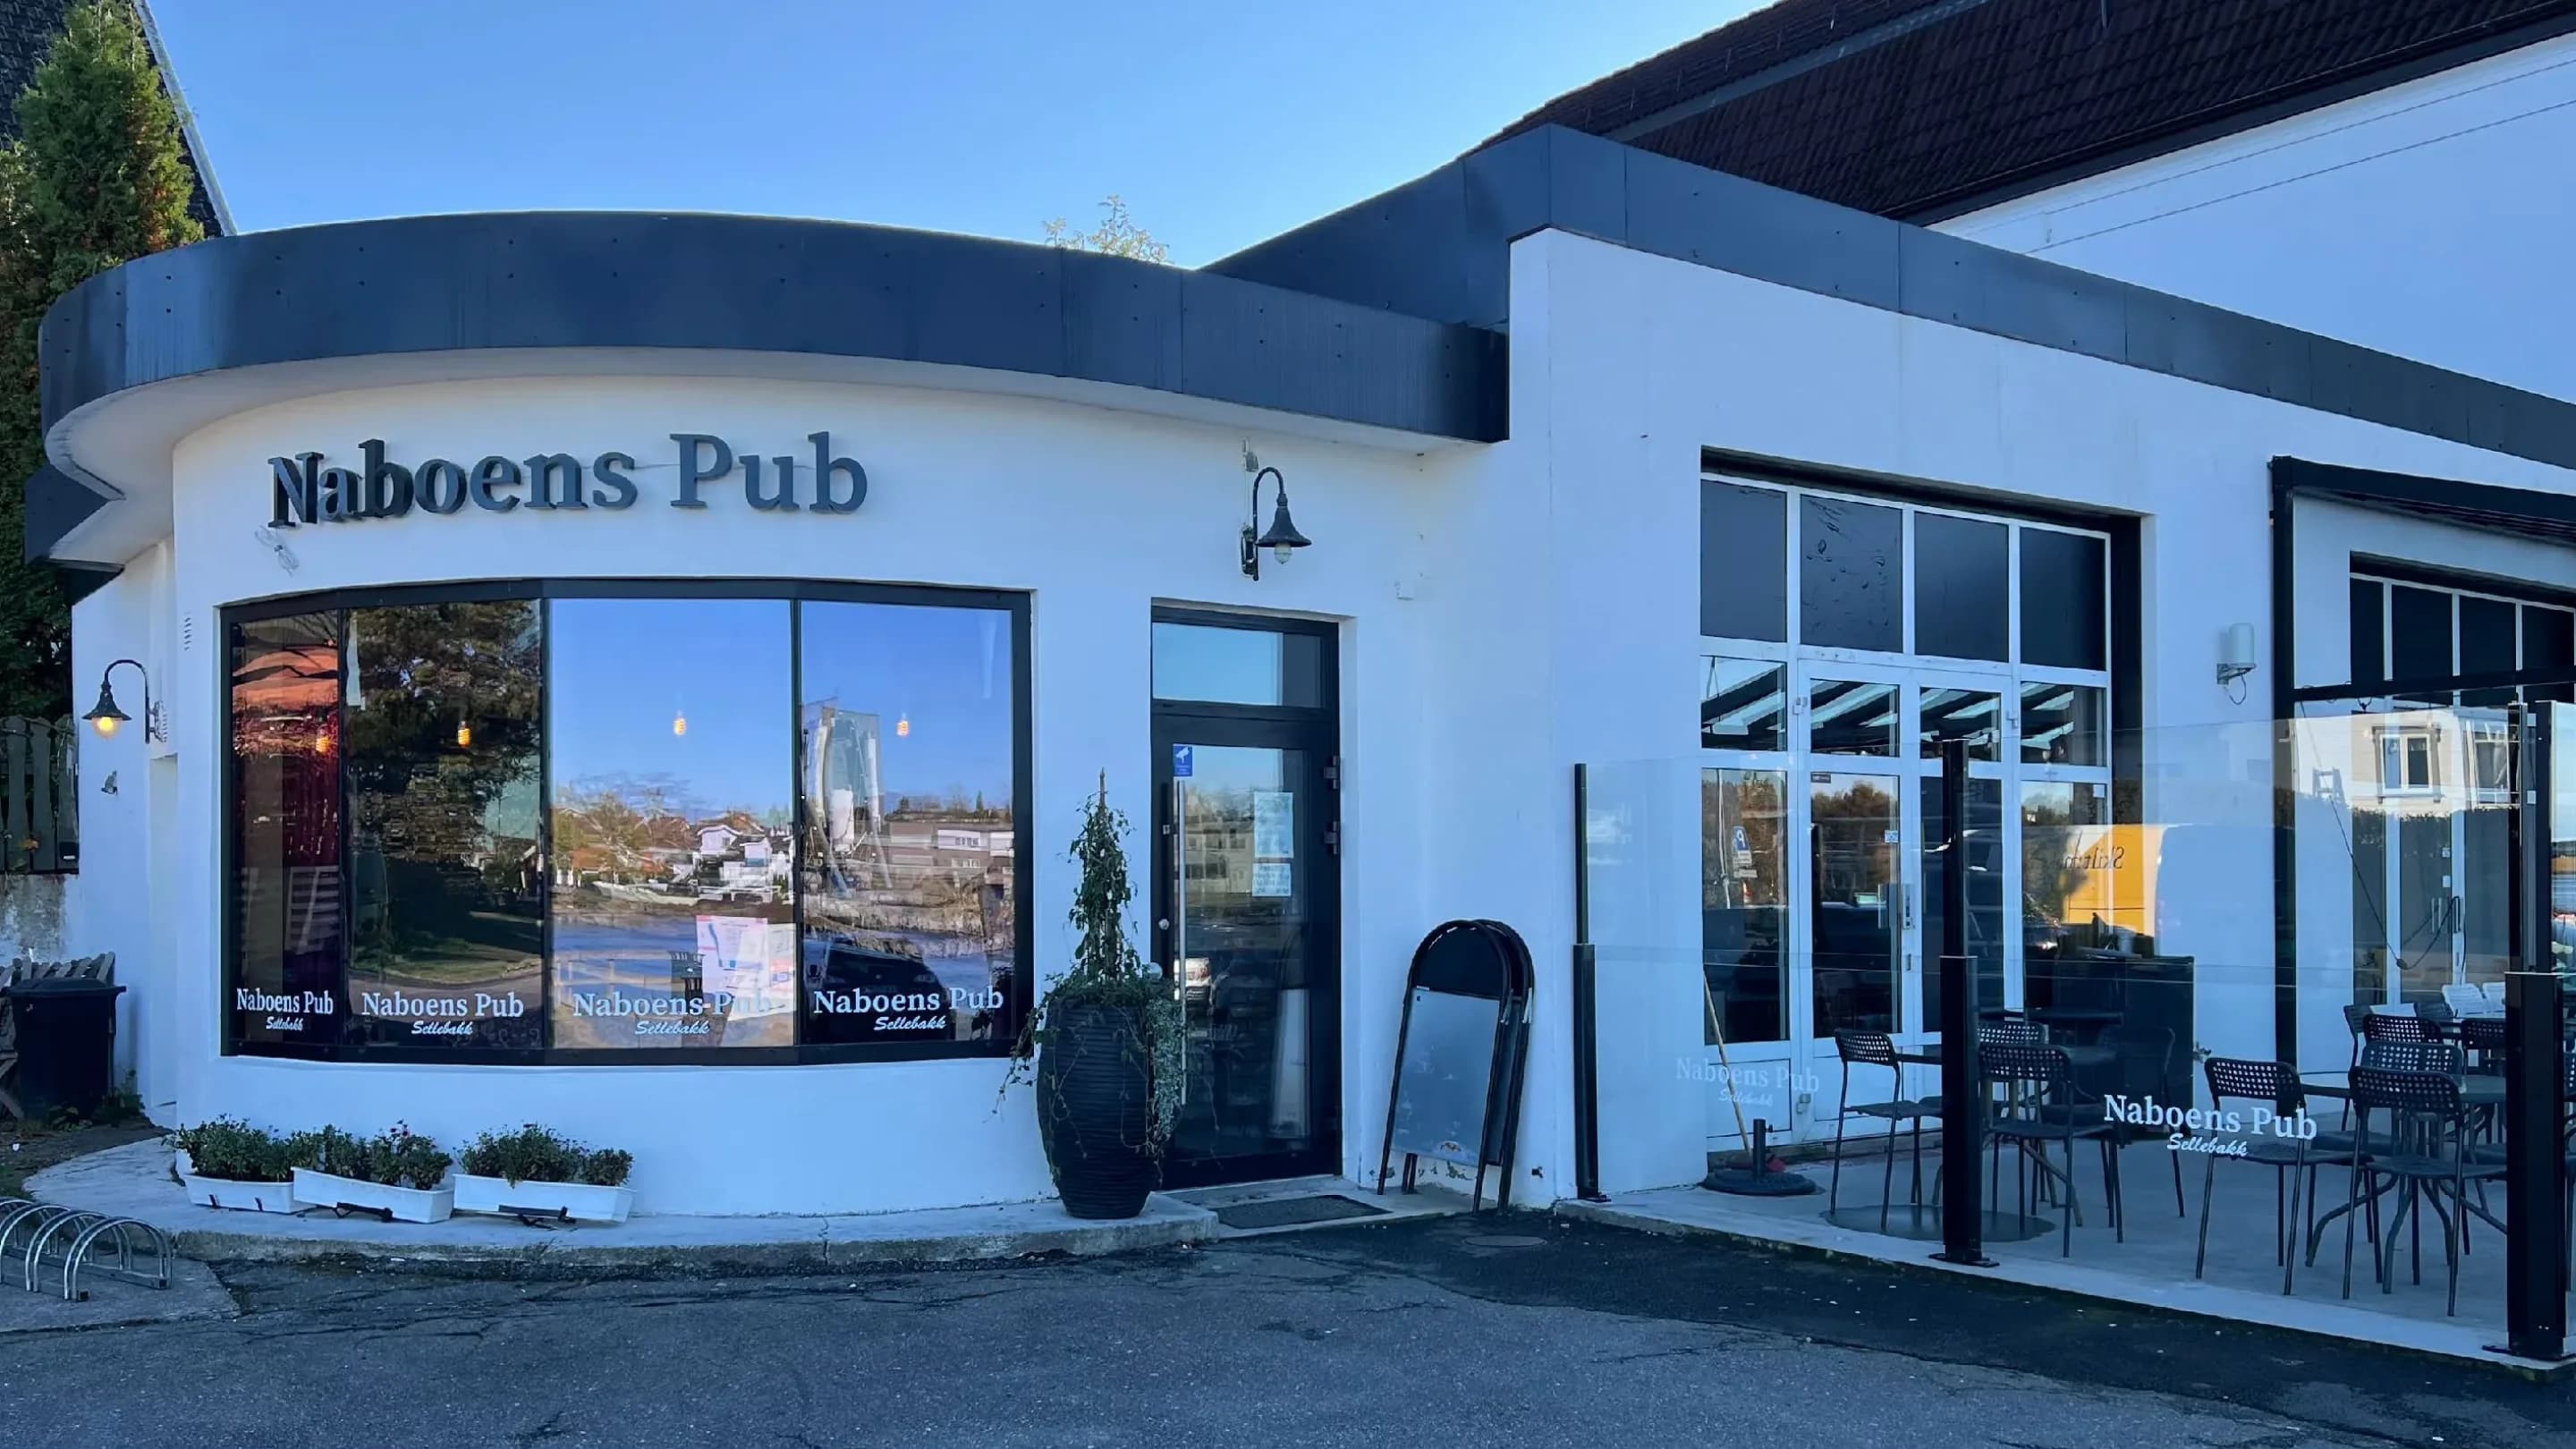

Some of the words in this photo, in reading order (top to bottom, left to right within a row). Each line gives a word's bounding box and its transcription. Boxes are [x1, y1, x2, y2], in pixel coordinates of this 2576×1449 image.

[267, 439, 637, 528] Naboens
[669, 431, 869, 513] Pub
[236, 987, 301, 1013] Naboens
[303, 989, 335, 1015] Pub
[361, 992, 468, 1017] Naboens
[474, 991, 525, 1018] Pub
[573, 991, 705, 1017] Naboens
[711, 989, 771, 1015] Pub
[813, 988, 940, 1014] Naboens
[949, 986, 1004, 1011] Pub
[266, 1015, 304, 1031] Sellebakk
[411, 1021, 474, 1036] Sellebakk
[634, 1021, 711, 1036] Sellebakk
[873, 1016, 948, 1031] Sellebakk
[1675, 1057, 1769, 1088] Naboens
[1775, 1063, 1820, 1093] Pub
[2104, 1094, 2241, 1133] Naboens
[2250, 1106, 2318, 1140] Pub
[2166, 1132, 2249, 1157] Sellebakk
